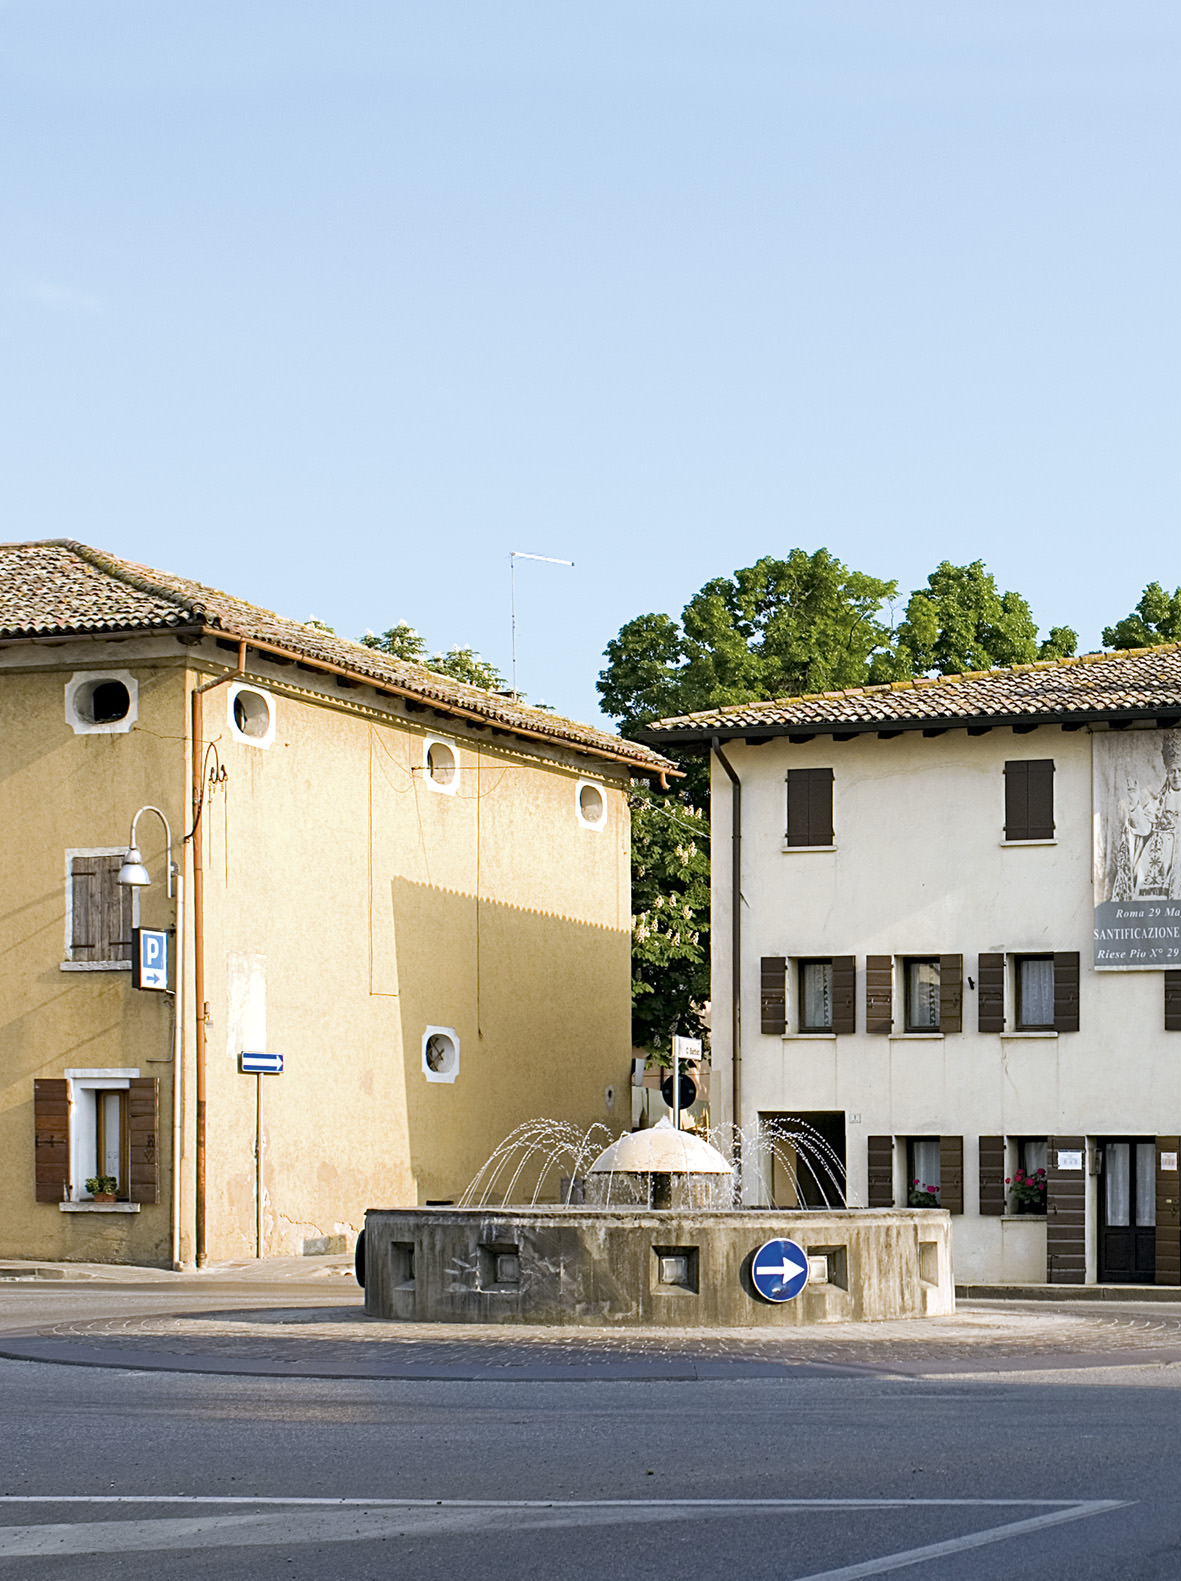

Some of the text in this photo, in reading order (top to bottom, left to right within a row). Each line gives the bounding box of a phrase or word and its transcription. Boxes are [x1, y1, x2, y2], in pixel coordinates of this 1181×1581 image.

[1116, 908, 1144, 918] Roma
[1148, 908, 1160, 917] 29
[1094, 926, 1180, 940] SANTIFICAZIONE
[146, 938, 159, 964] P
[1097, 949, 1126, 958] Riese
[1130, 948, 1146, 958] Pio
[1149, 948, 1164, 958] X°
[1166, 948, 1180, 957] 29
